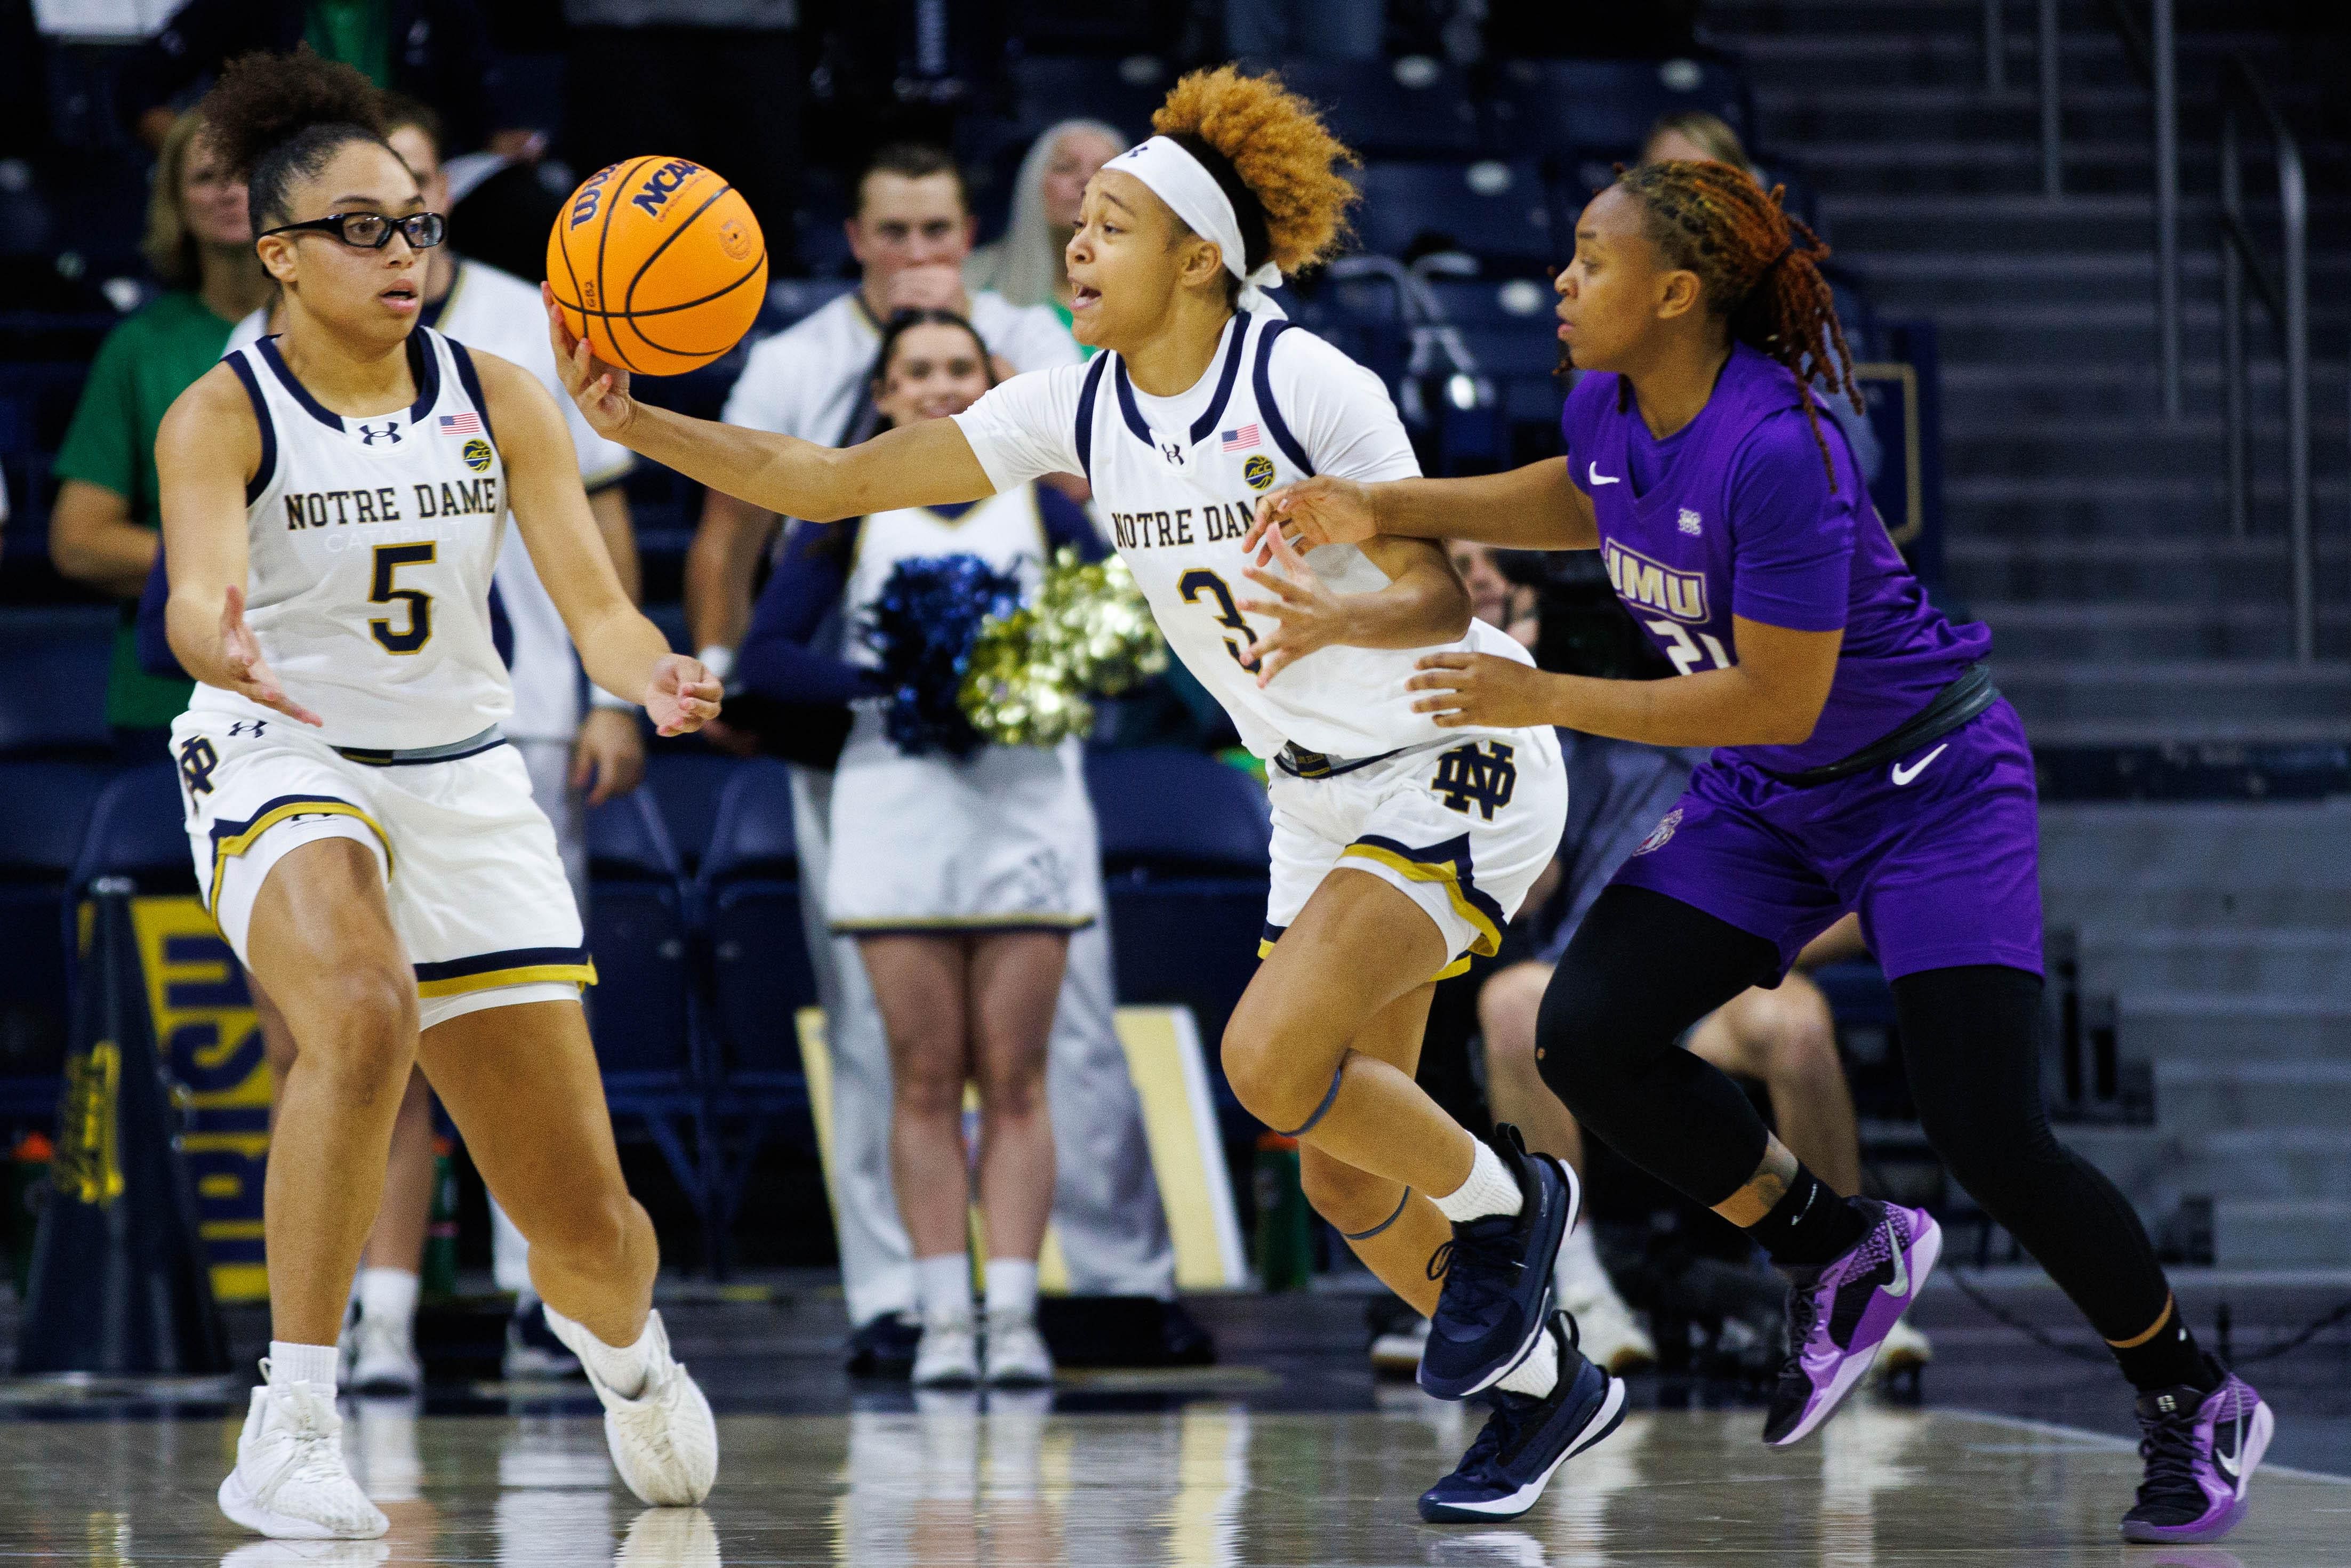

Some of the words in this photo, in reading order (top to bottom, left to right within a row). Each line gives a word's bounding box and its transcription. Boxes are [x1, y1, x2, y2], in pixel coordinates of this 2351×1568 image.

[285, 487, 401, 530] NOTRE
[413, 478, 497, 518] DAME
[1112, 509, 1194, 549] NOTRE
[367, 540, 436, 655] 5
[1176, 567, 1262, 675] 3
